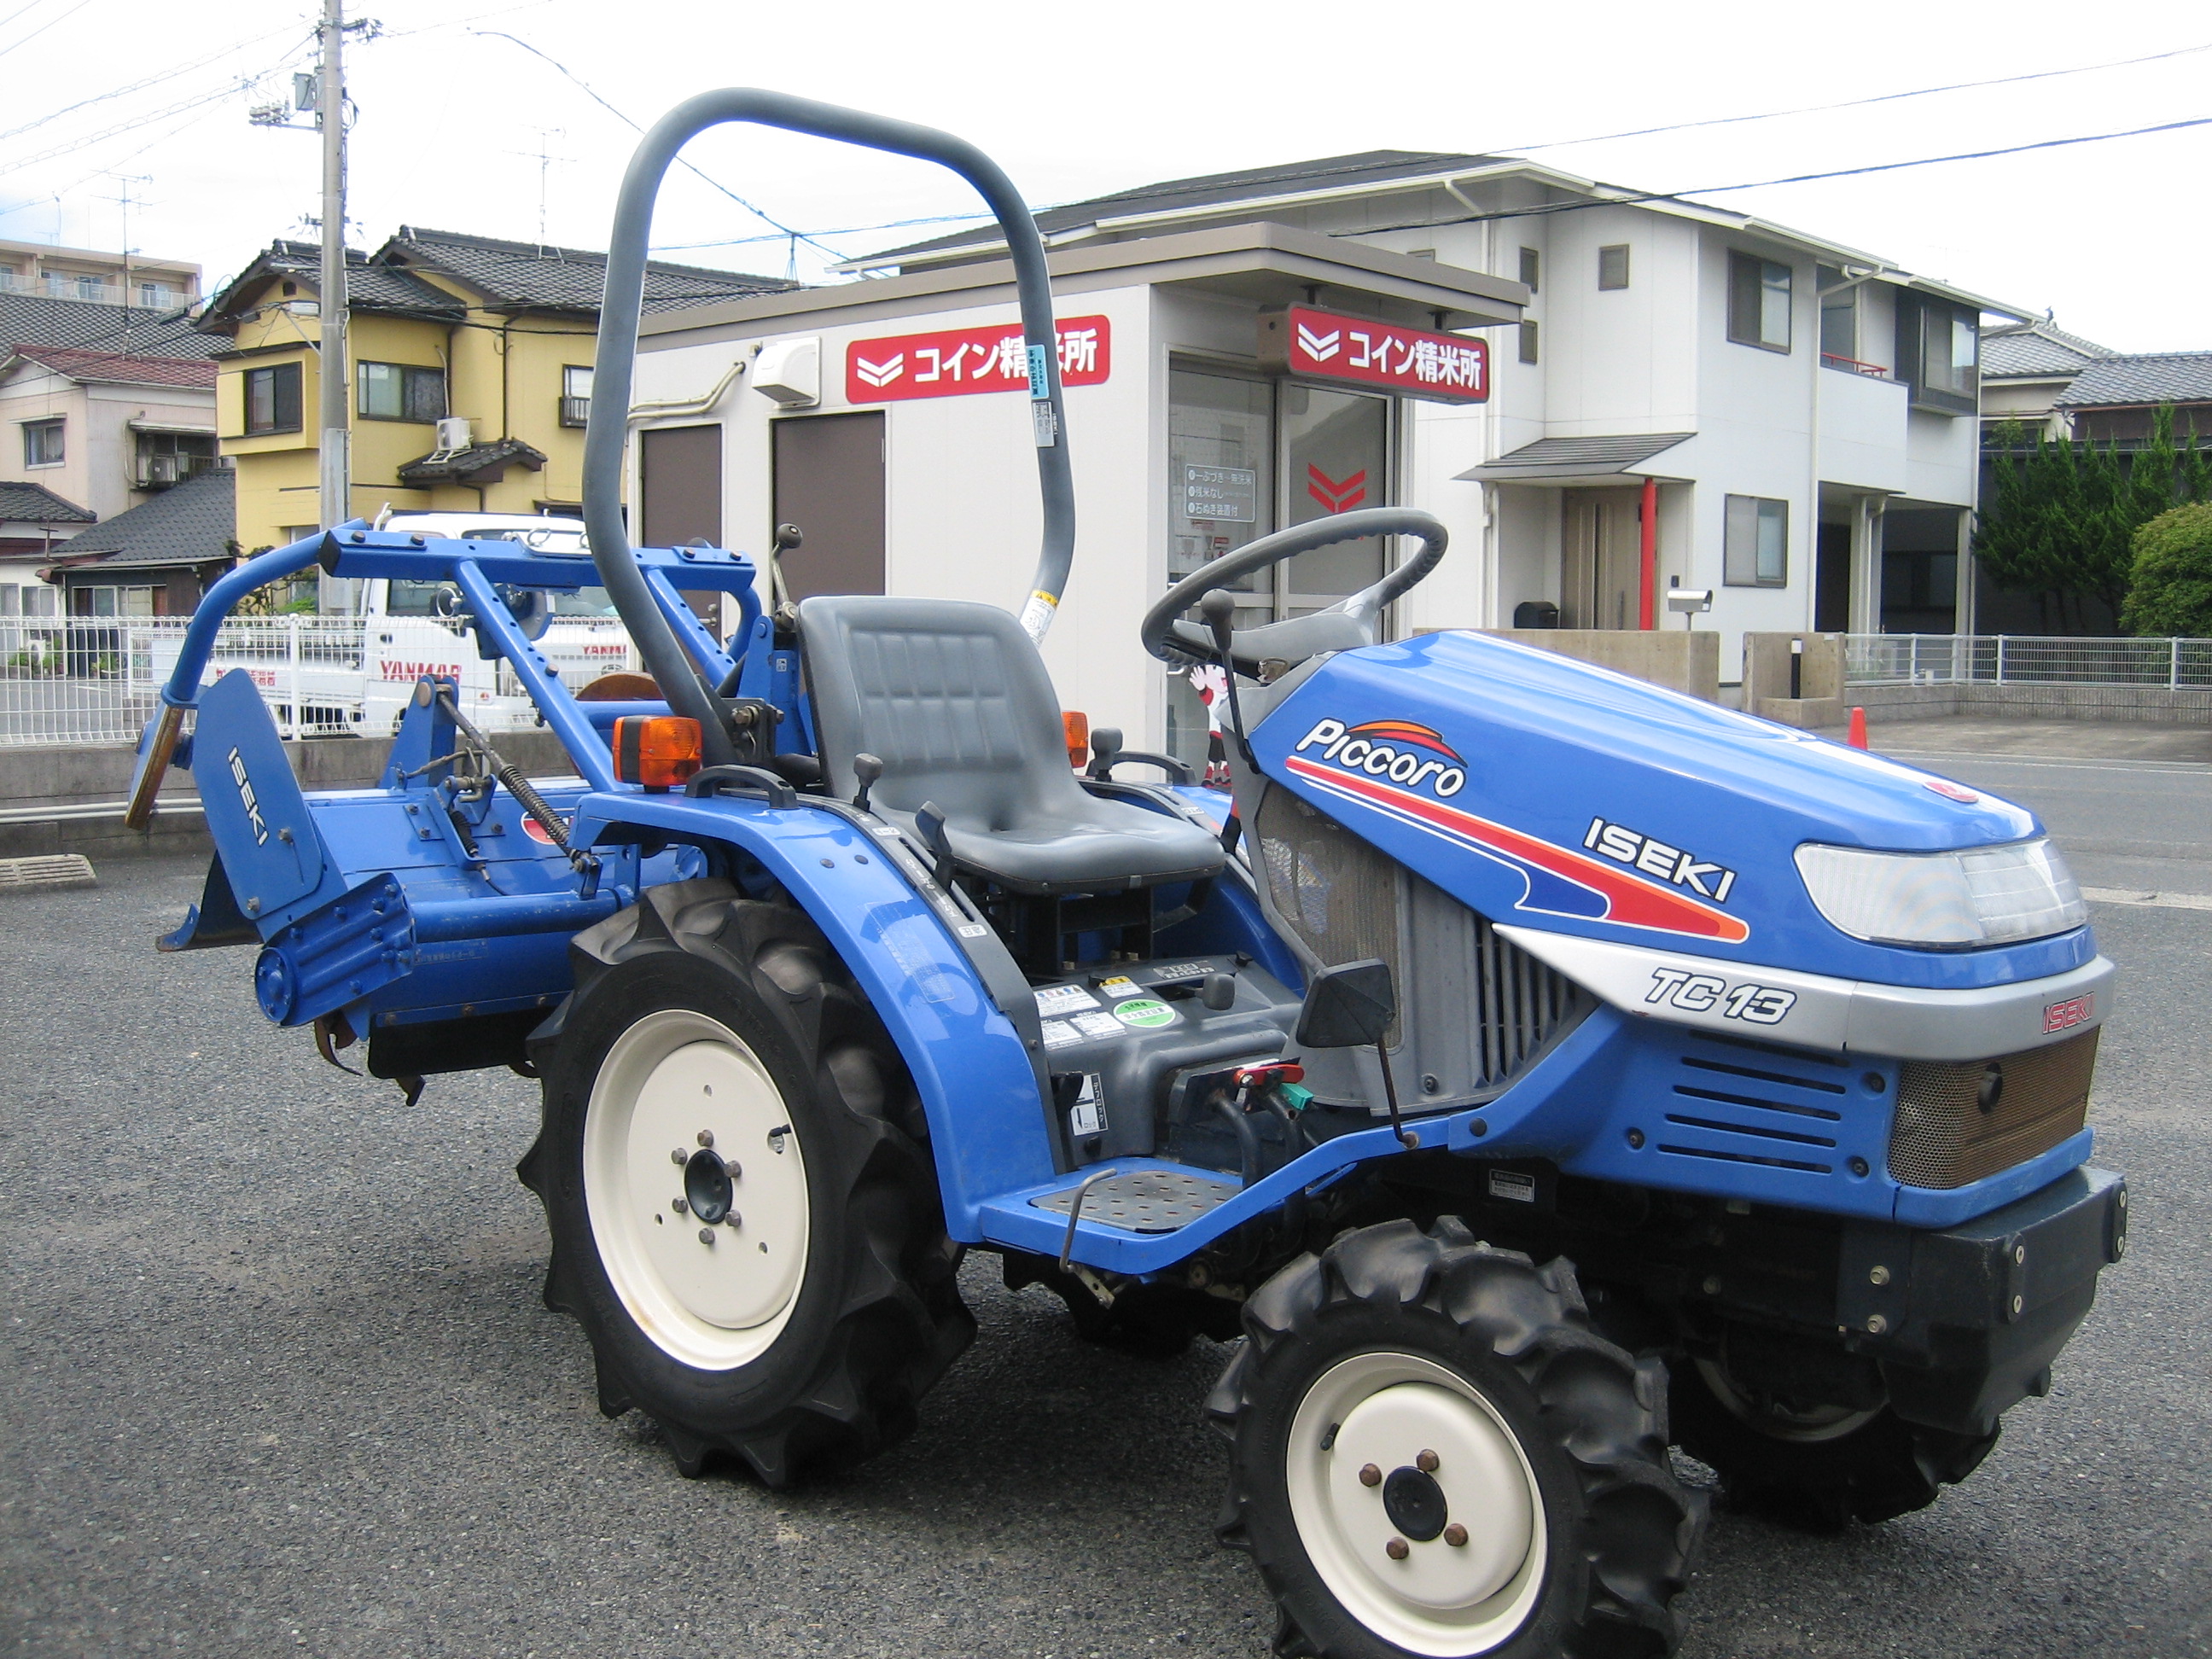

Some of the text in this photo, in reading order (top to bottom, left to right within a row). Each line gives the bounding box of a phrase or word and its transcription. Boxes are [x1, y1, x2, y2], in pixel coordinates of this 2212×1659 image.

[915, 328, 1098, 382] コイン精所
[1348, 331, 1482, 391] コイン精米所
[1295, 716, 1466, 798] Piccoro
[228, 745, 269, 847] ISEKI
[1582, 815, 1738, 905] ISEKI
[2042, 991, 2095, 1035] ISEKI
